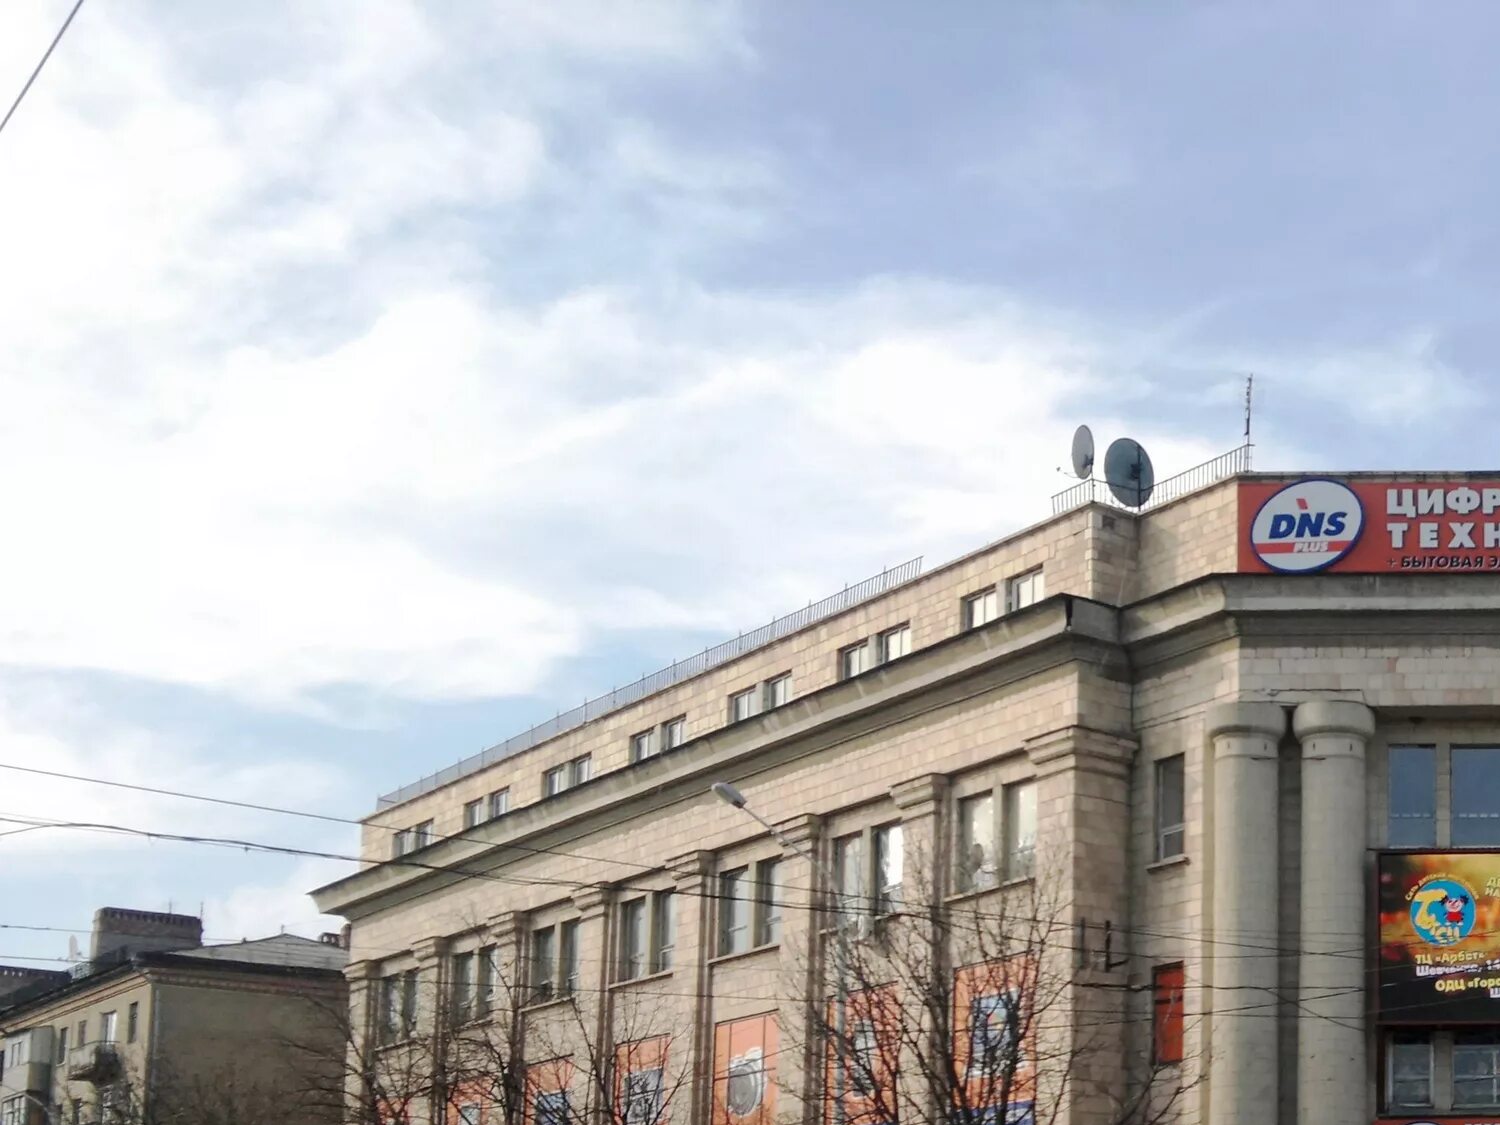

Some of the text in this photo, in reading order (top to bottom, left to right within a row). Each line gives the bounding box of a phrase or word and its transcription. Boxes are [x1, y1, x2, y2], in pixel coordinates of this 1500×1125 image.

[1268, 510, 1346, 539] DNS
[1293, 540, 1329, 554] PLUS
[1401, 555, 1484, 569] БЫТОВАЯ
[1415, 953, 1433, 966] ТЦ
[1435, 979, 1466, 993] ОДЦ
